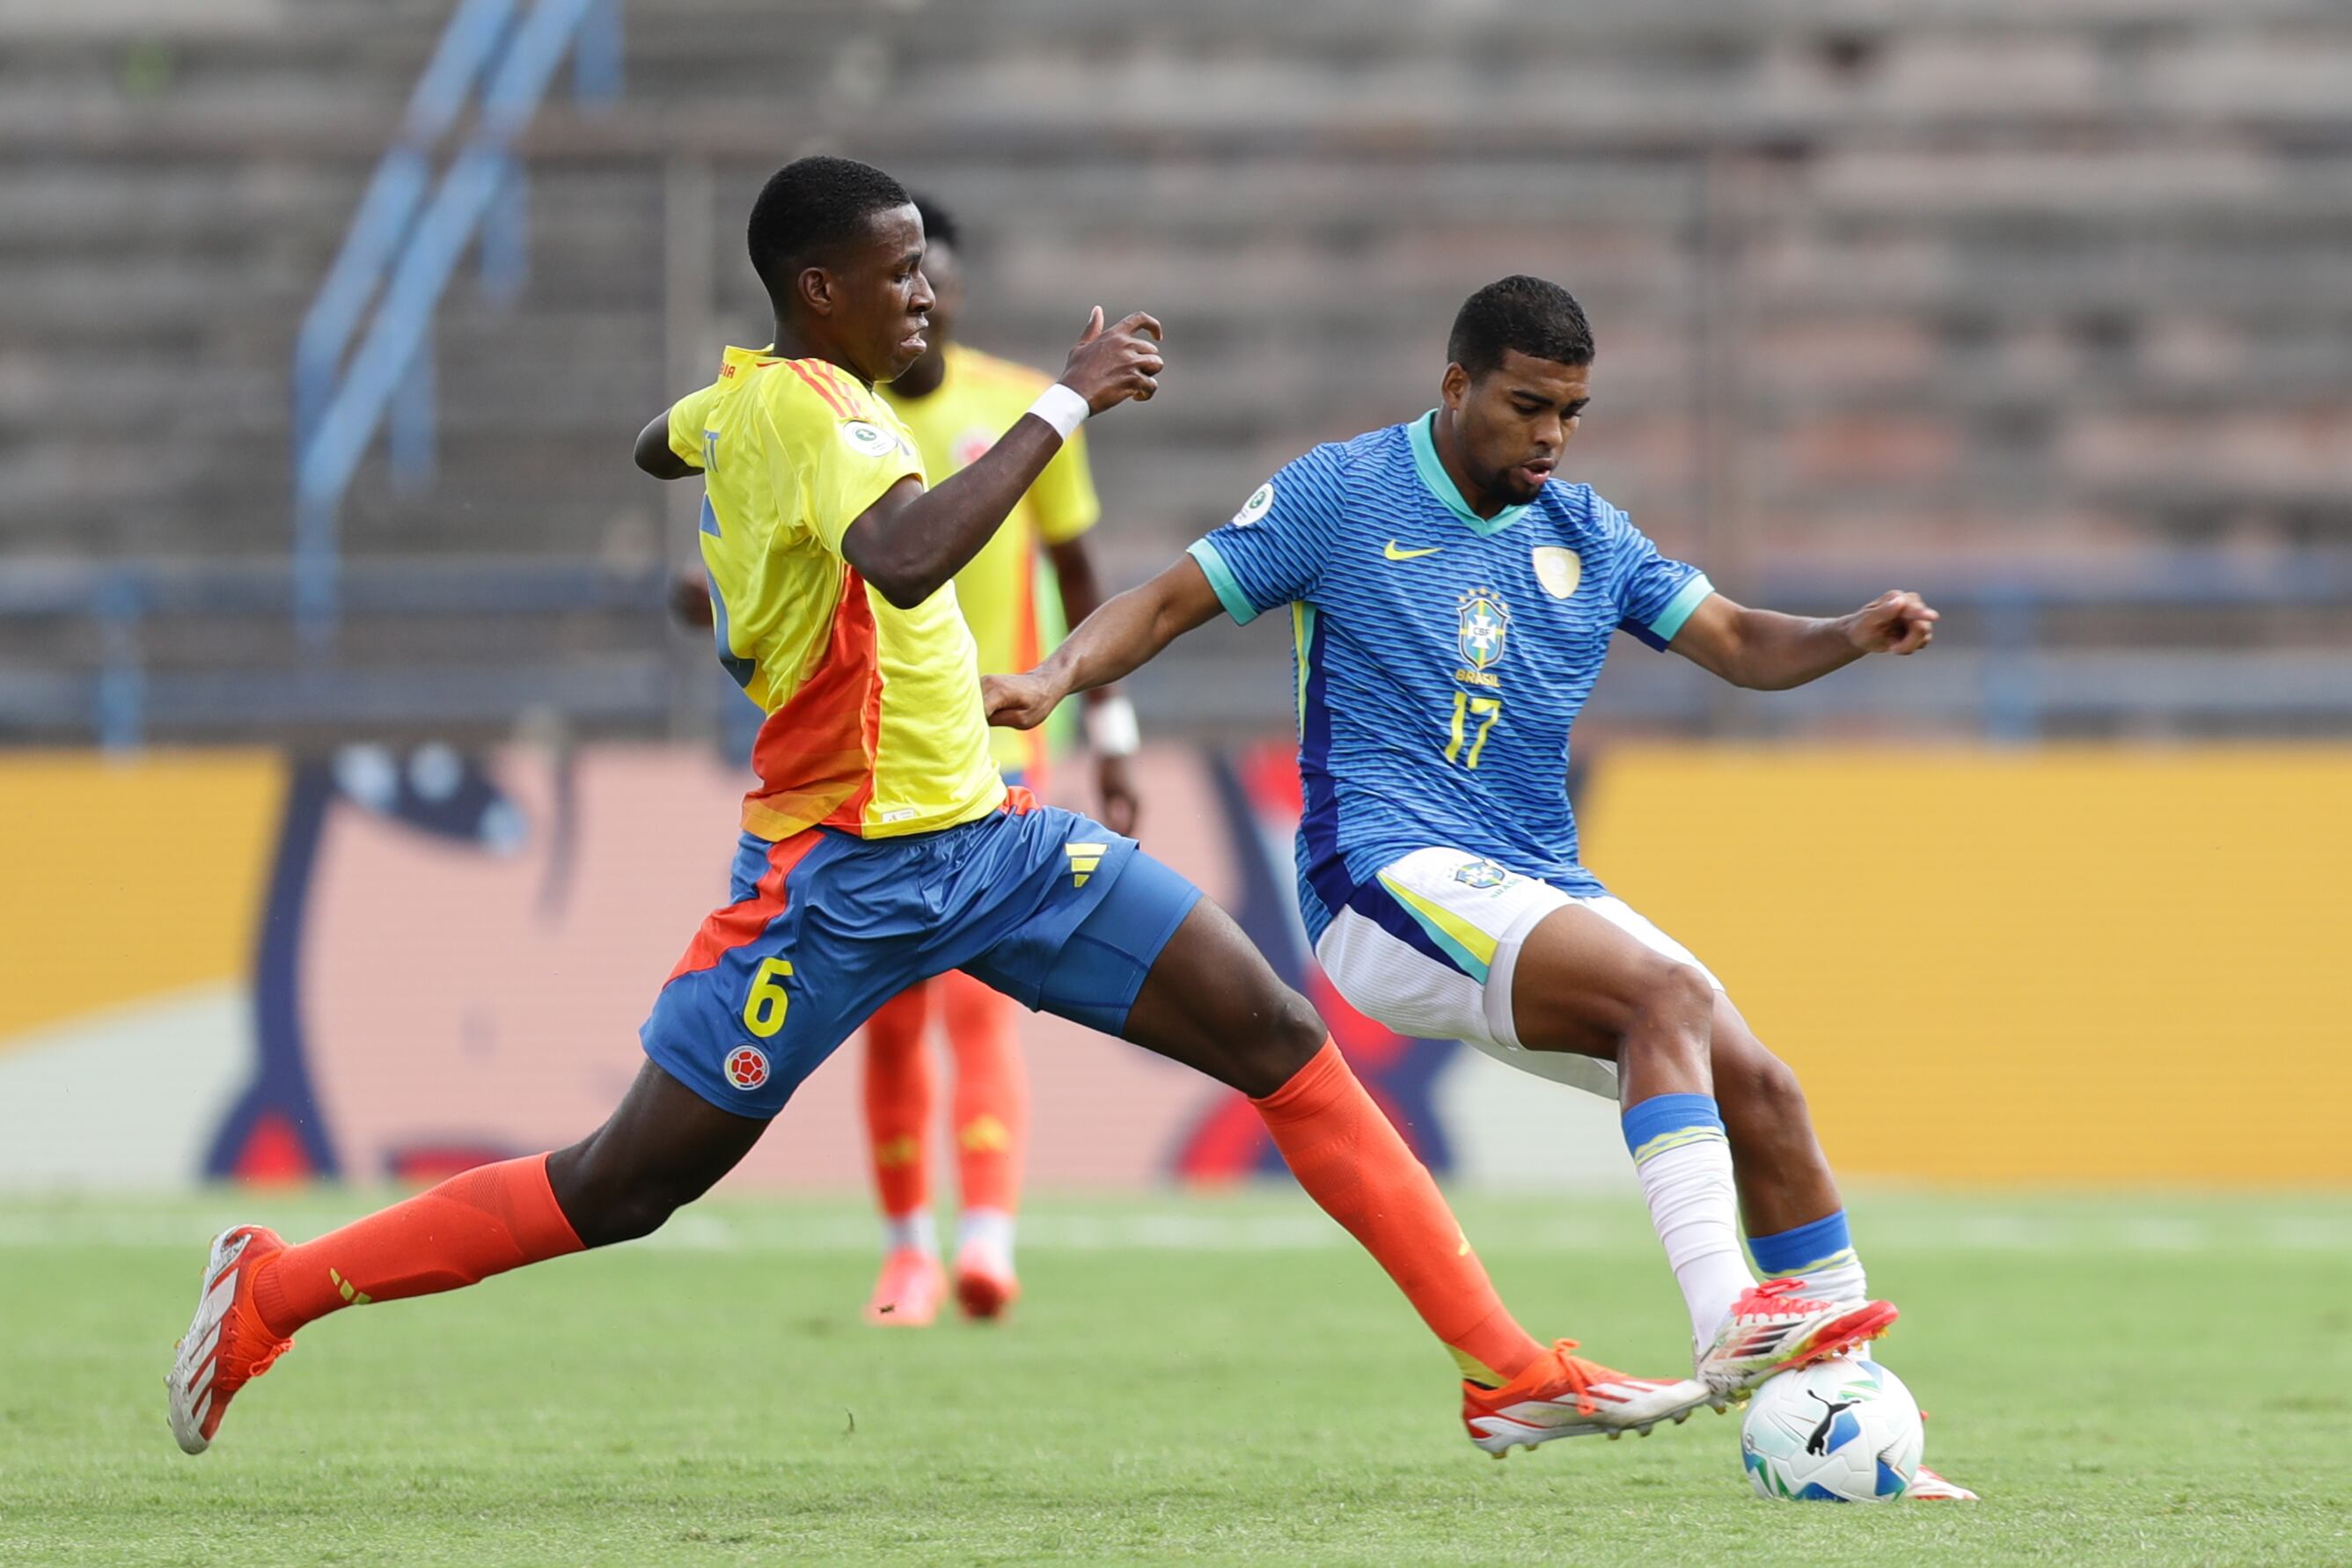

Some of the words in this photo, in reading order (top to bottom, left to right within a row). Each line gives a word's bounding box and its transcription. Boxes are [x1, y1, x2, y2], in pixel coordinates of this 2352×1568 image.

[1456, 670, 1500, 687] BRASIL
[1445, 690, 1501, 769] 17
[744, 956, 793, 1038] 6
